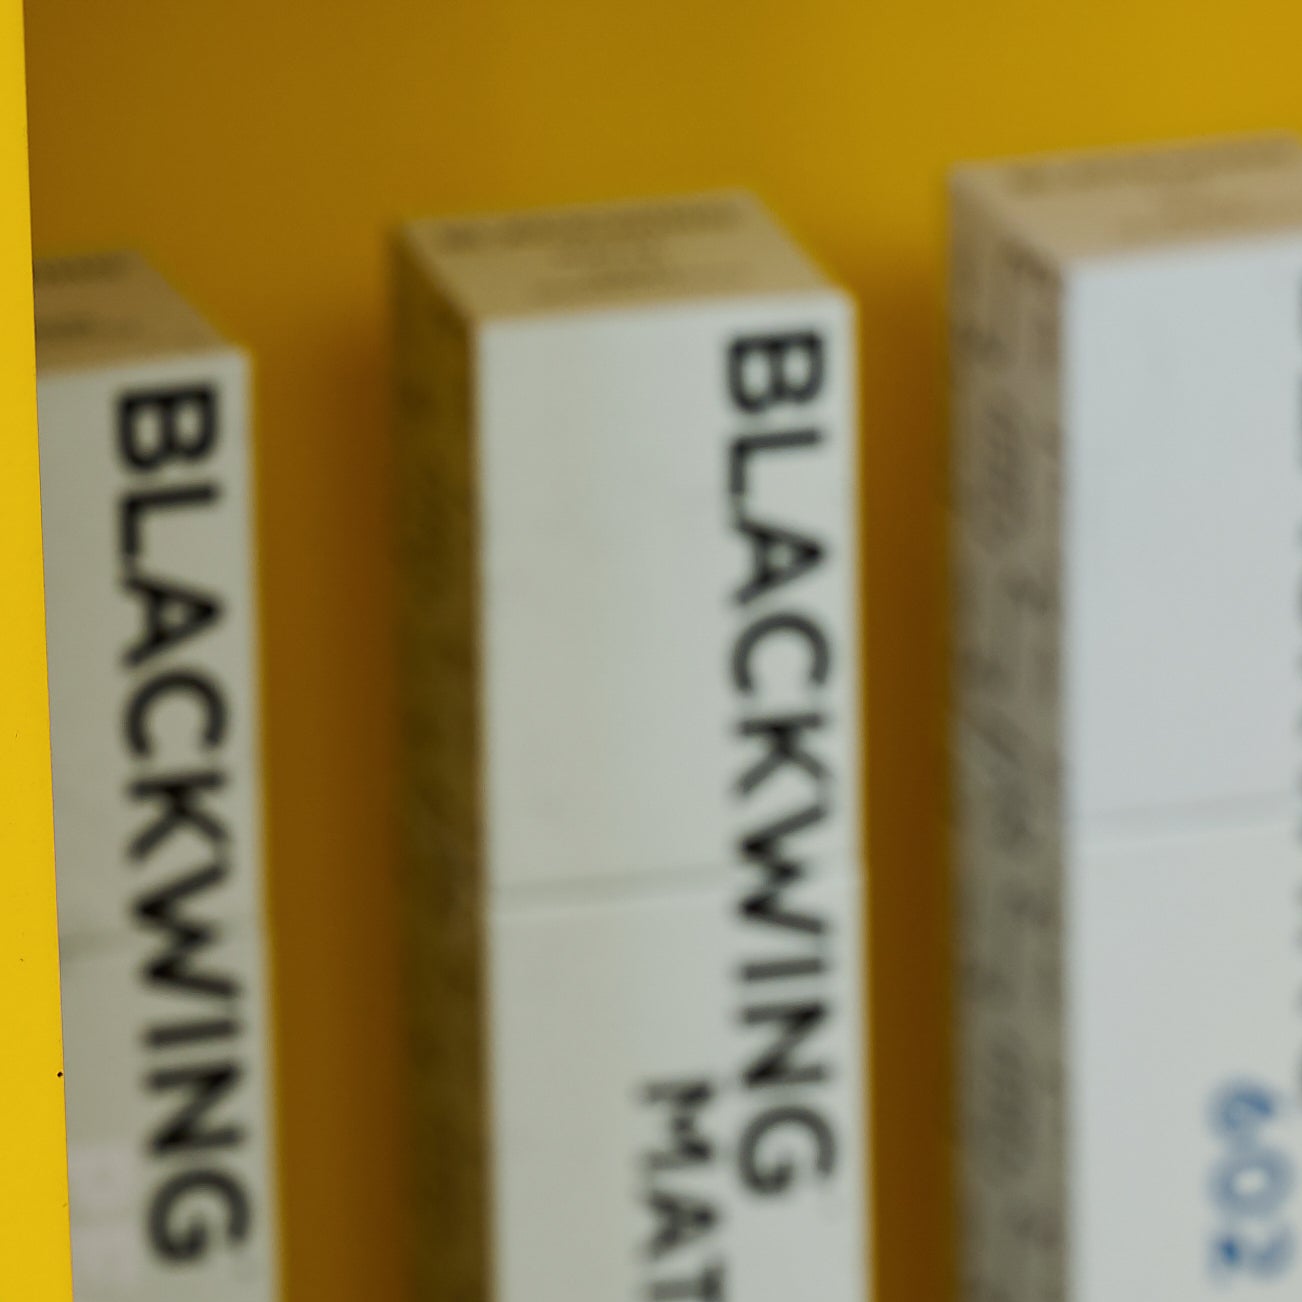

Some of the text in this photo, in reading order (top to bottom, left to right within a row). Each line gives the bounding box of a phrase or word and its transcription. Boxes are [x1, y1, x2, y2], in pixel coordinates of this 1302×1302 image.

[115, 382, 252, 1268] BLACKWING
[726, 328, 836, 1200] BLACKWING
[1206, 1076, 1293, 1284] 602
